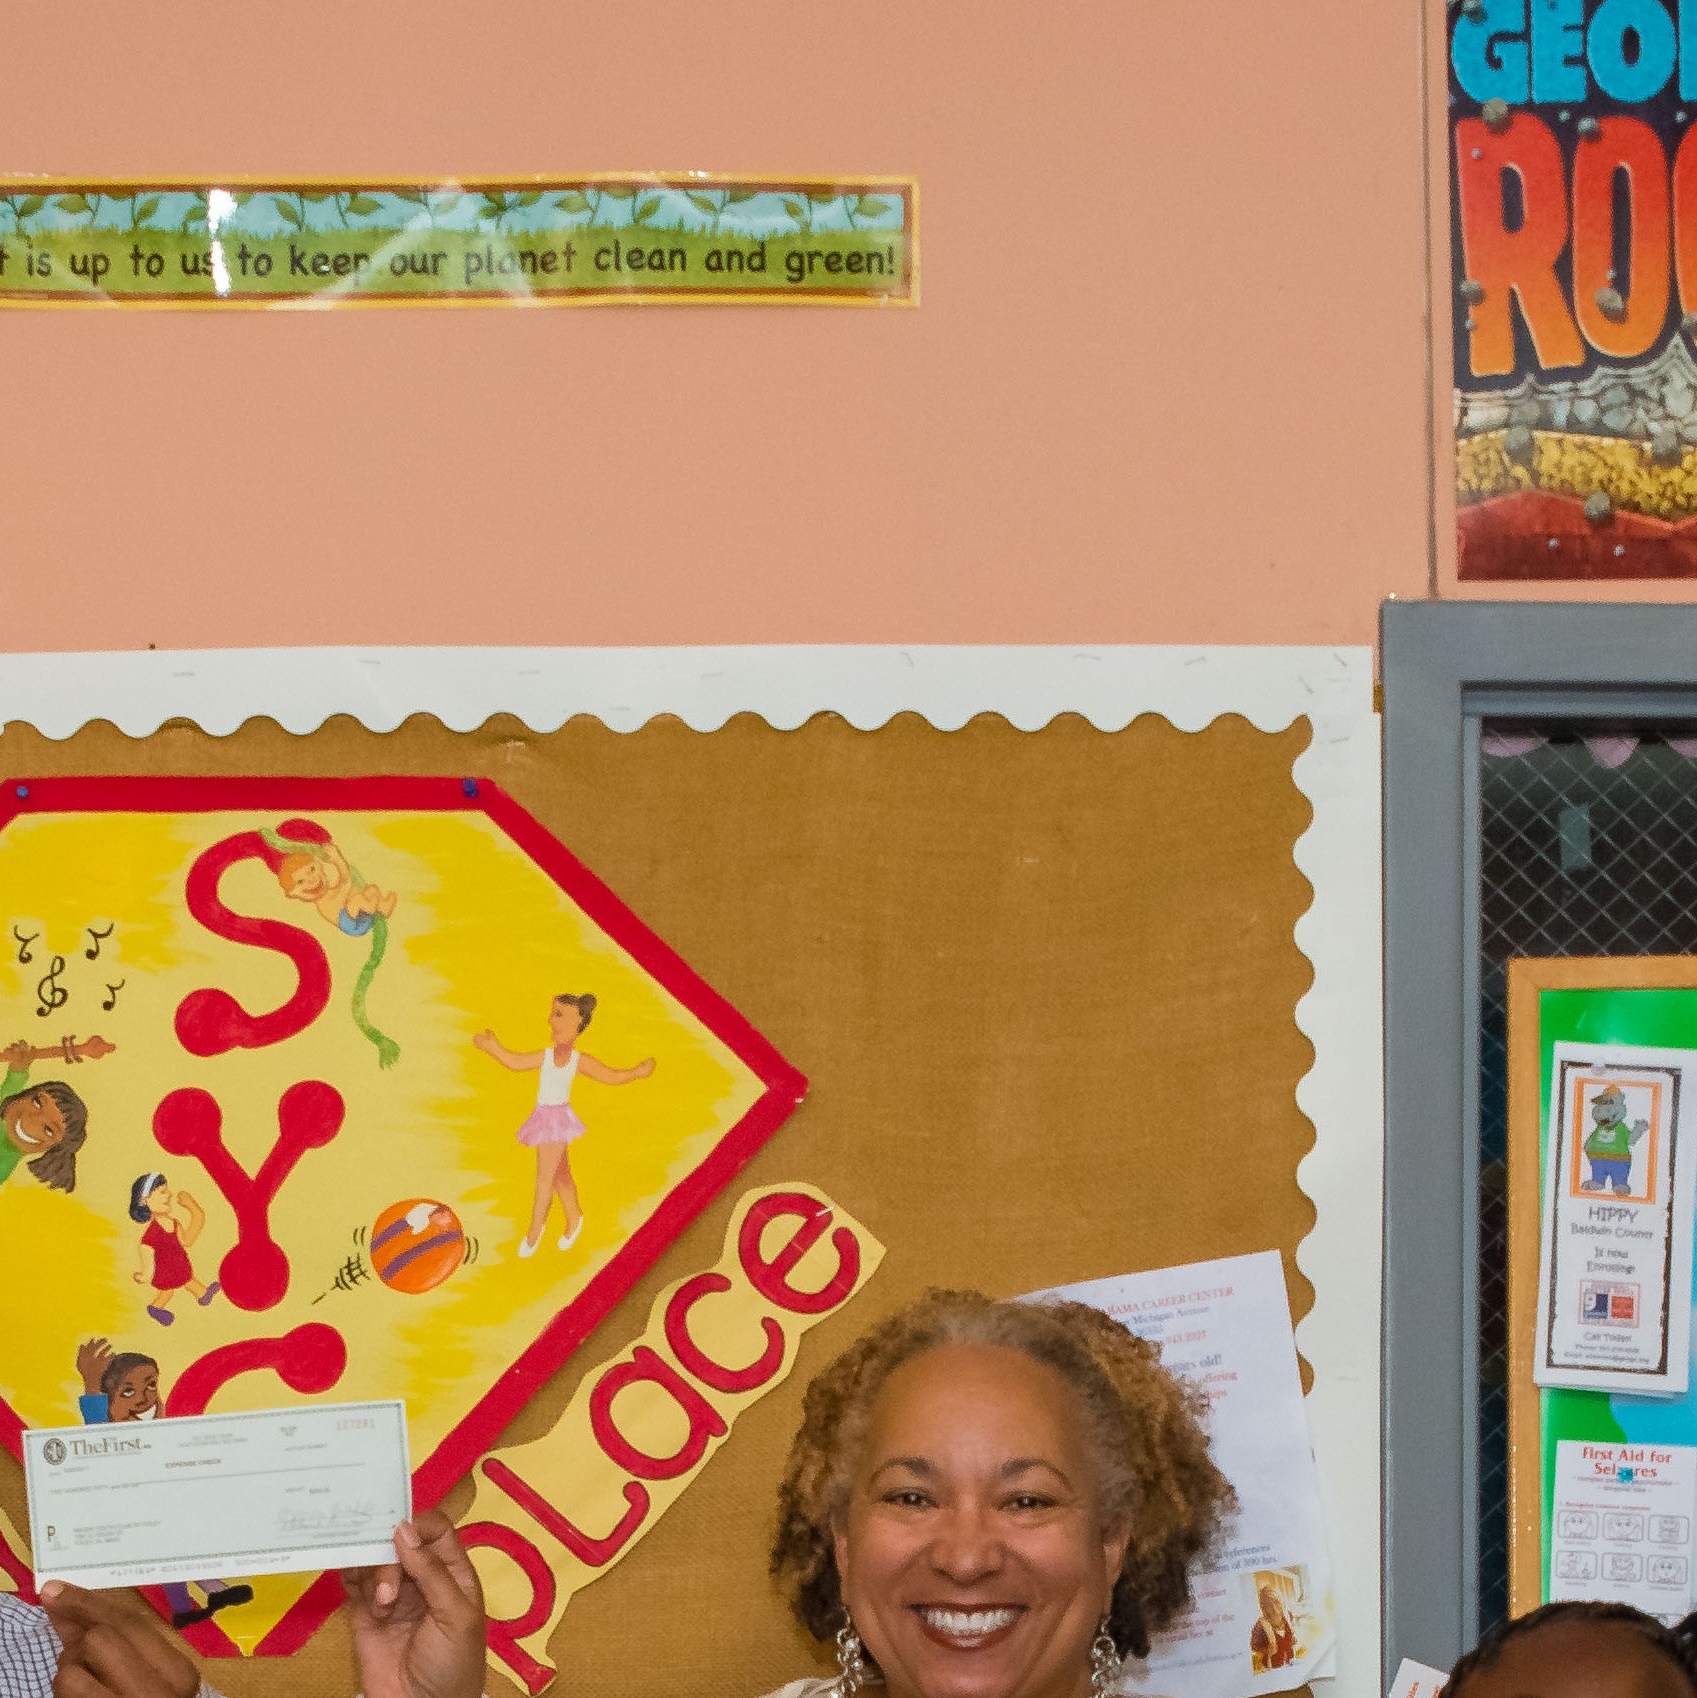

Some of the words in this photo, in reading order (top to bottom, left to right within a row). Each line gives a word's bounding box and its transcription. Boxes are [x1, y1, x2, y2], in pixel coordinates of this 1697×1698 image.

[25, 243, 52, 277] is
[69, 249, 110, 287] up
[131, 244, 164, 277] to
[180, 248, 214, 277] us
[239, 244, 272, 278] to
[290, 244, 370, 287] keep
[390, 248, 443, 277] our
[465, 240, 577, 287] planet
[593, 238, 687, 274] clean
[705, 241, 767, 275] and
[784, 243, 895, 285] green!
[1188, 1286, 1235, 1305] CENTER
[1582, 1446, 1612, 1461] First
[1618, 1447, 1644, 1462] Aid
[1650, 1449, 1672, 1463] for
[1594, 1462, 1658, 1478] Seires
